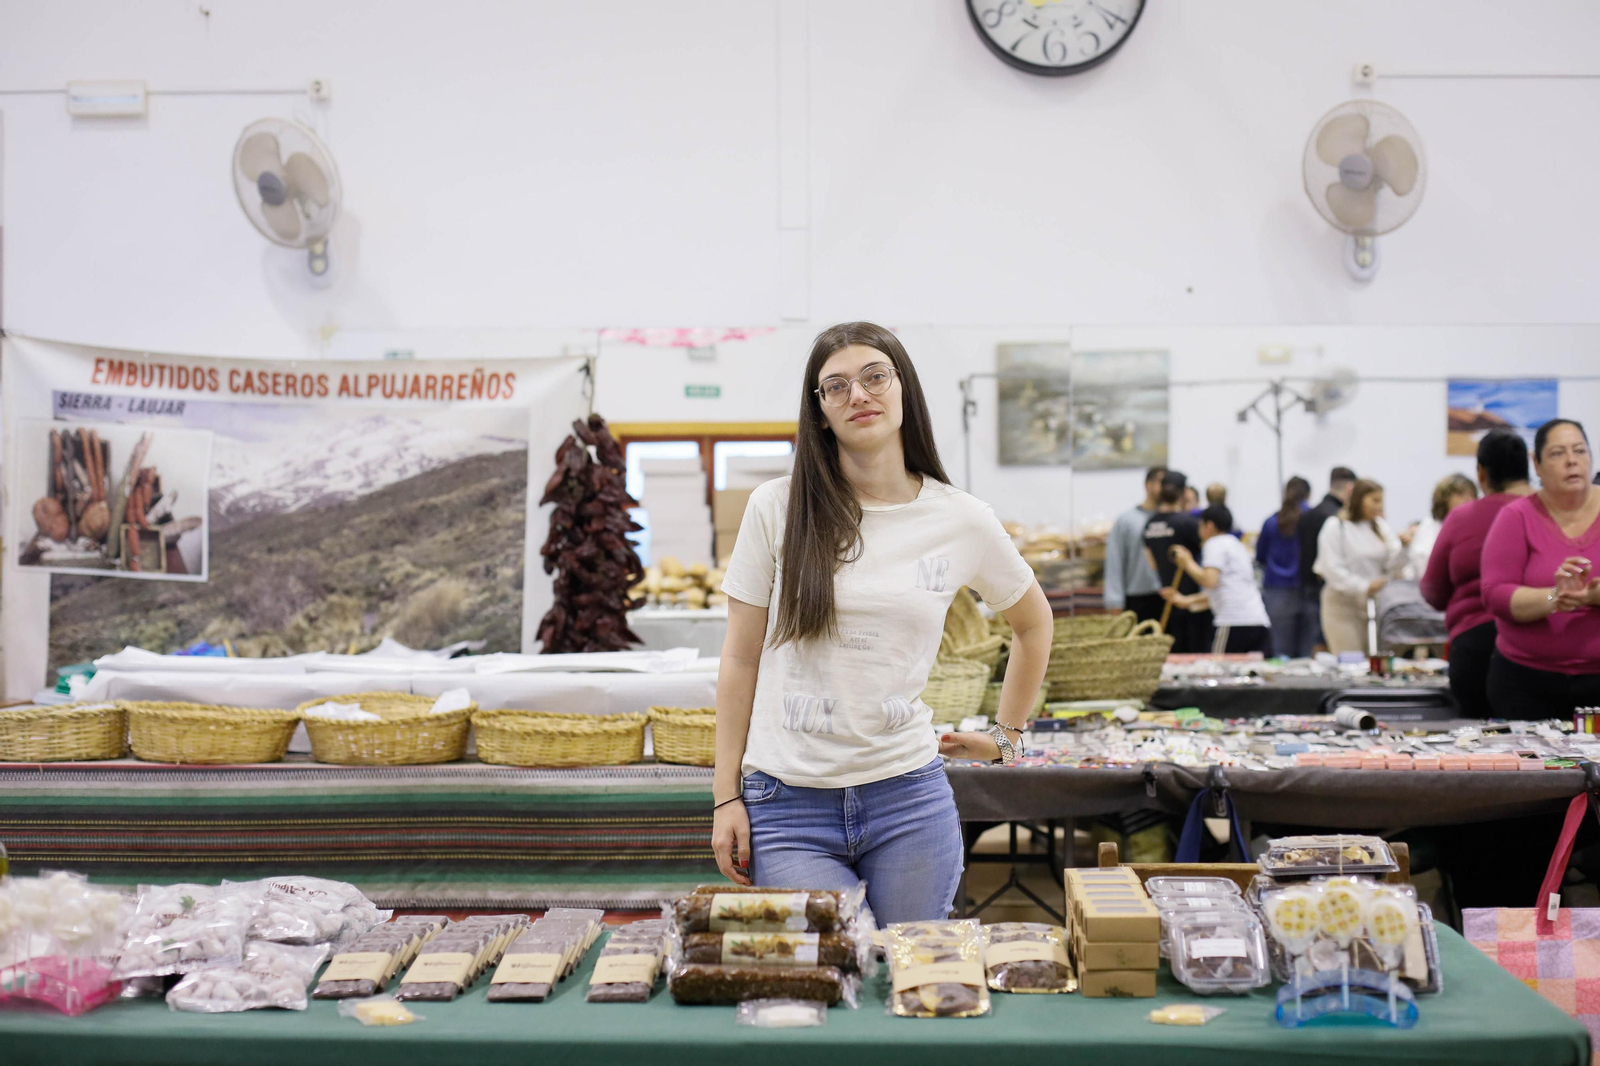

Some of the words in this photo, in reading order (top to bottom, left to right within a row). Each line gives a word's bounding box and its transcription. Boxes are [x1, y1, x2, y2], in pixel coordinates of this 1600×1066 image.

[1010, 18, 1040, 53] 7
[1042, 27, 1067, 63] 6
[92, 357, 219, 393] EMBUTIDOS
[229, 368, 329, 398] CASEROS
[338, 368, 516, 400] ALPUJARREÑOS
[59, 391, 113, 411] SIERRA
[128, 397, 187, 416] LAUJAR
[914, 556, 950, 593] NE
[839, 642, 861, 650] Letting
[858, 629, 879, 637] French
